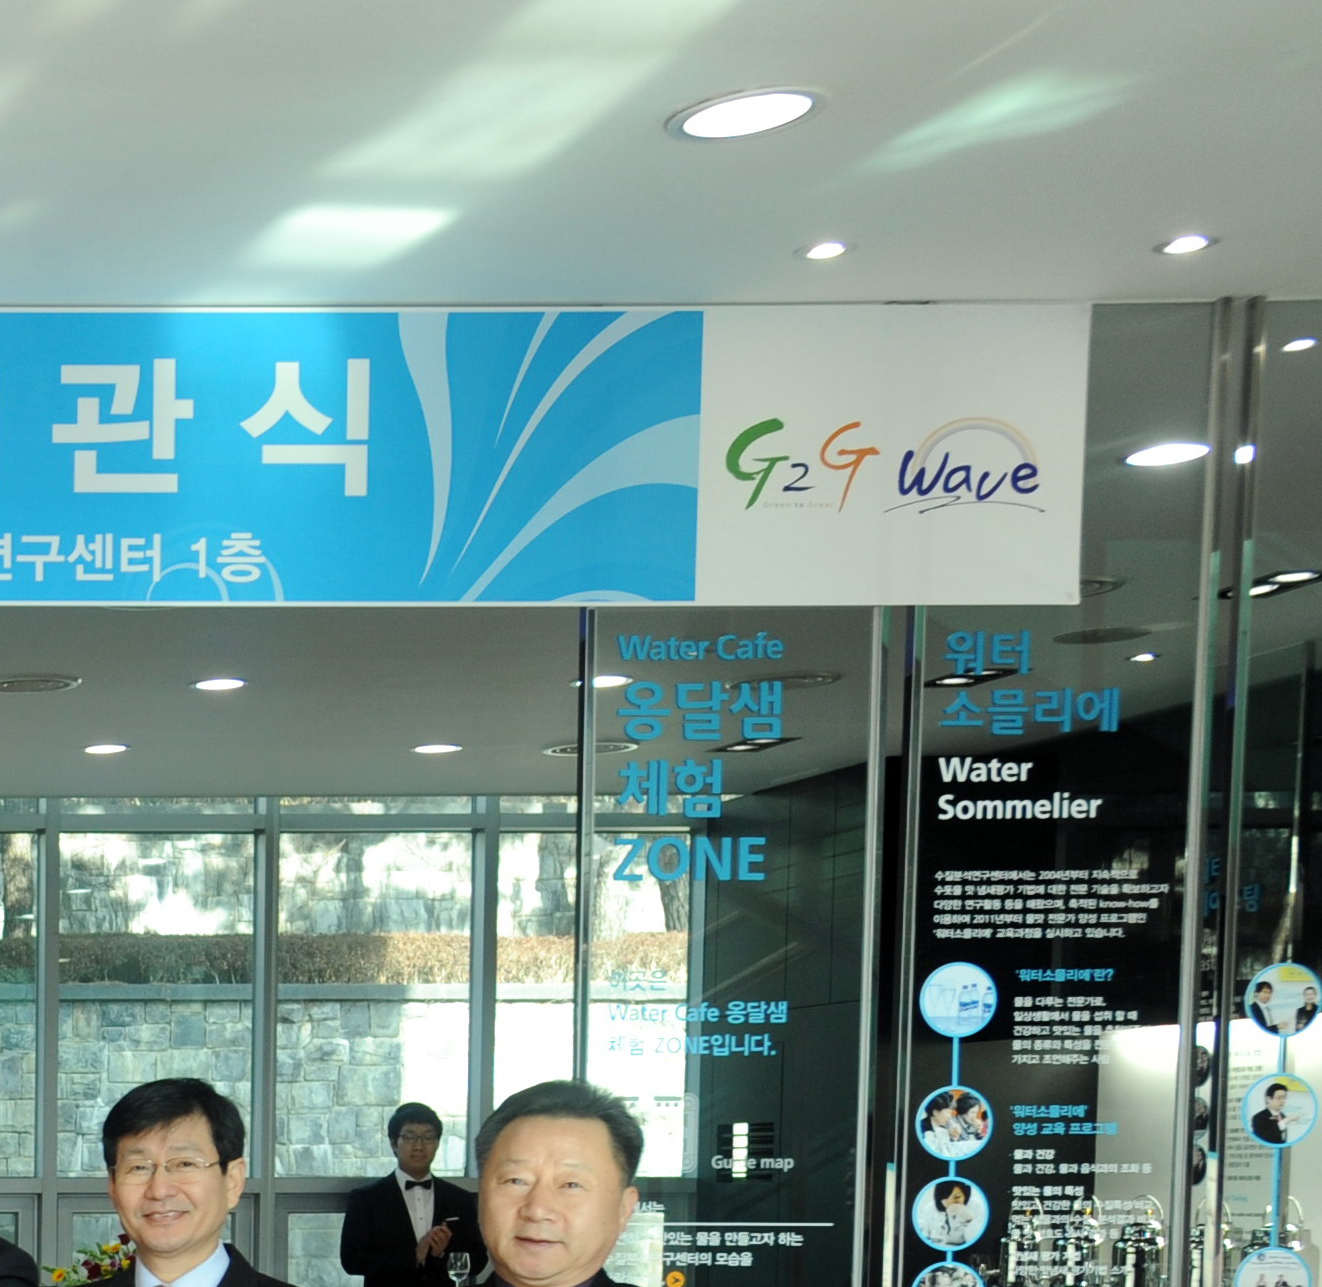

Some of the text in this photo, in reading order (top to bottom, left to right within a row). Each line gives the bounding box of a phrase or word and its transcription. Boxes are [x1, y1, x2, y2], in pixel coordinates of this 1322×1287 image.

[191, 532, 266, 582] 1층
[617, 631, 784, 660] Water Cafe
[944, 629, 1032, 675] 워터
[617, 680, 784, 741] 옹달샘
[939, 687, 1121, 735] 소믈리에
[618, 758, 724, 819] 체험
[938, 757, 1034, 783] Water
[937, 792, 1103, 820] Sommelier
[612, 836, 767, 881] ZONE
[675, 1001, 720, 1023] Cafe
[725, 1000, 789, 1024] 옹달샘
[711, 1155, 795, 1172] Gue map
